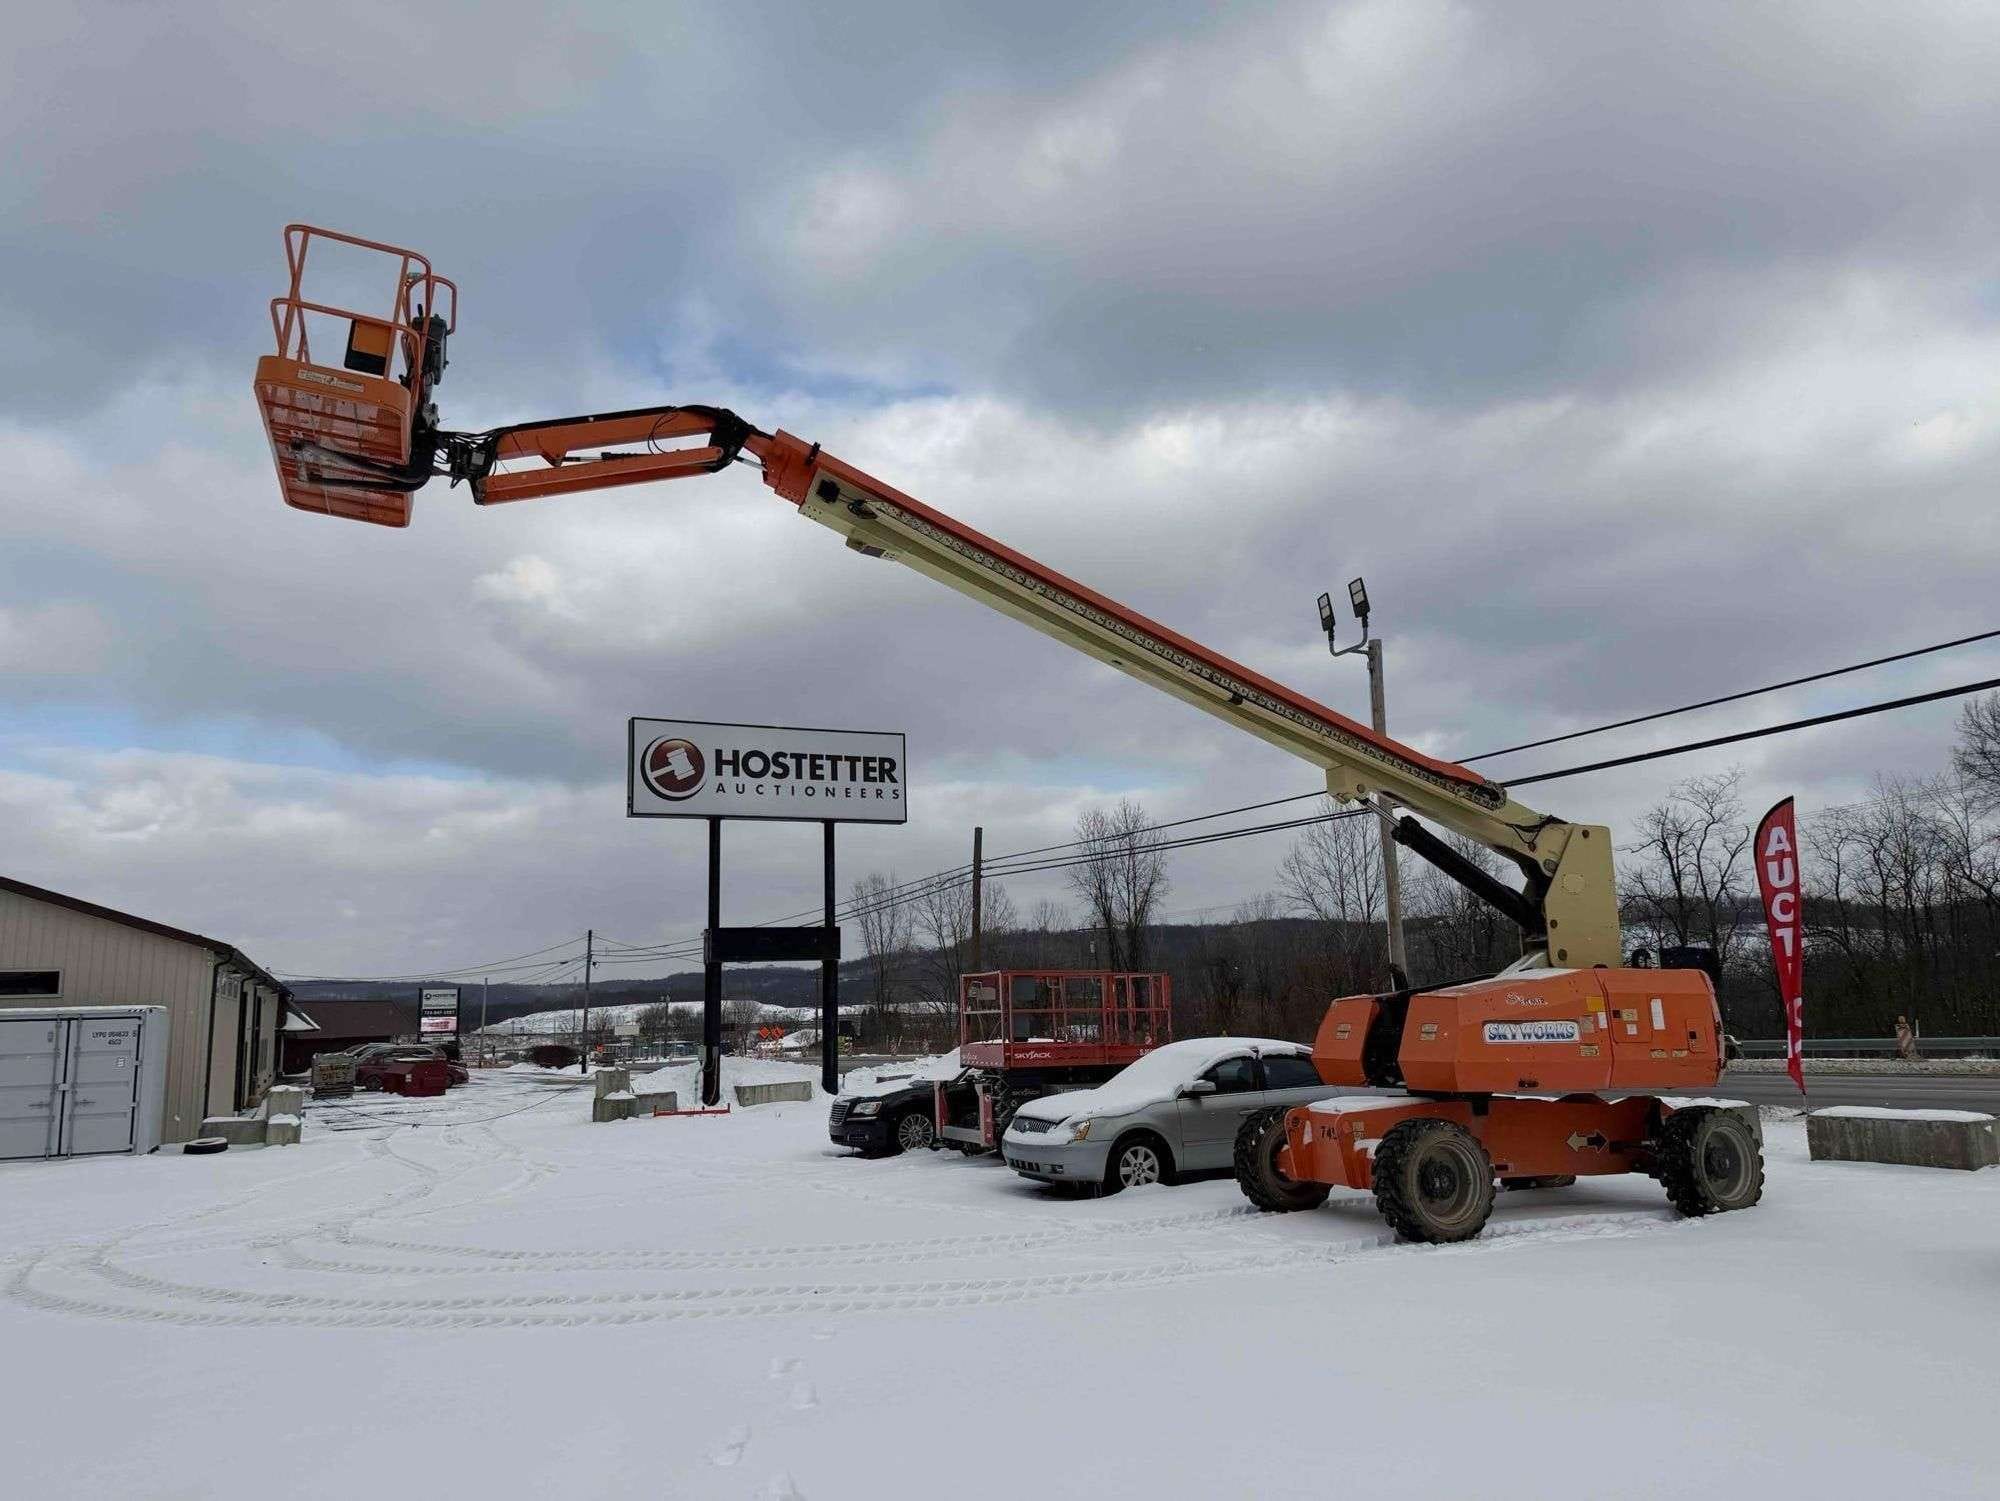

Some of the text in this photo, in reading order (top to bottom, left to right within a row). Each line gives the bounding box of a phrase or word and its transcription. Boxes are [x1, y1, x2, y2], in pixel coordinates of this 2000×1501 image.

[714, 748, 899, 784] HOSTETTER
[716, 782, 900, 800] AUCTIONEERS
[1487, 1022, 1578, 1041] SKYWORKS
[1013, 1050, 1052, 1060] SKYJACK
